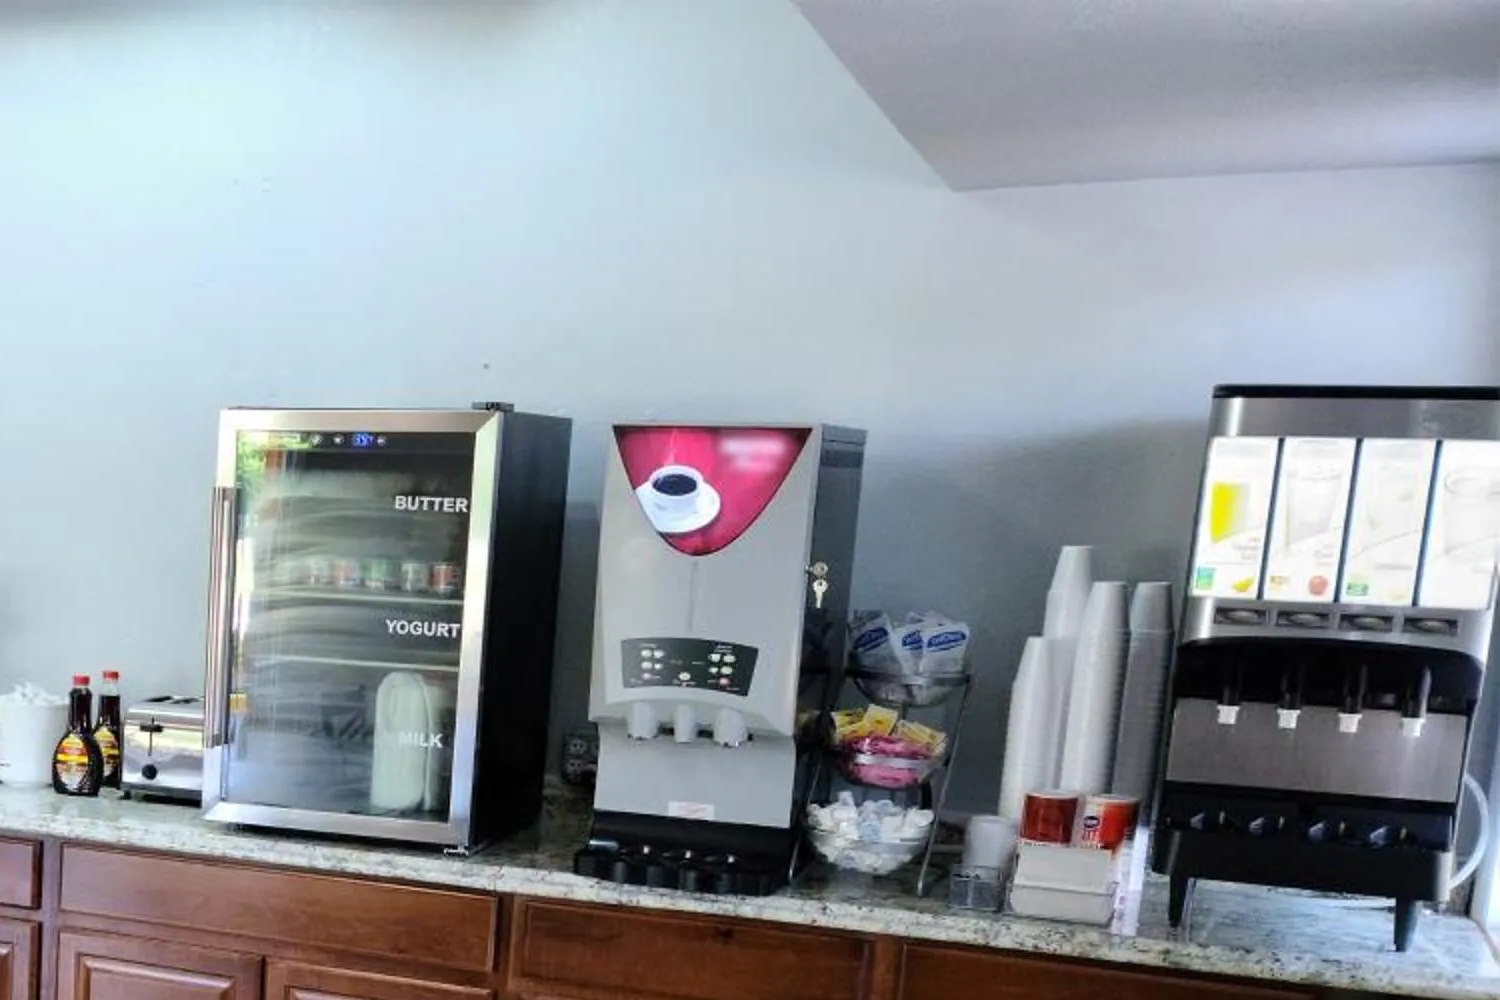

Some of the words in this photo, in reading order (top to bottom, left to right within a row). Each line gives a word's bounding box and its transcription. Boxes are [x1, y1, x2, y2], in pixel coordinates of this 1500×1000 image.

[395, 495, 468, 513] BUTTER
[385, 619, 461, 638] YOGURT
[399, 731, 444, 748] MILK
